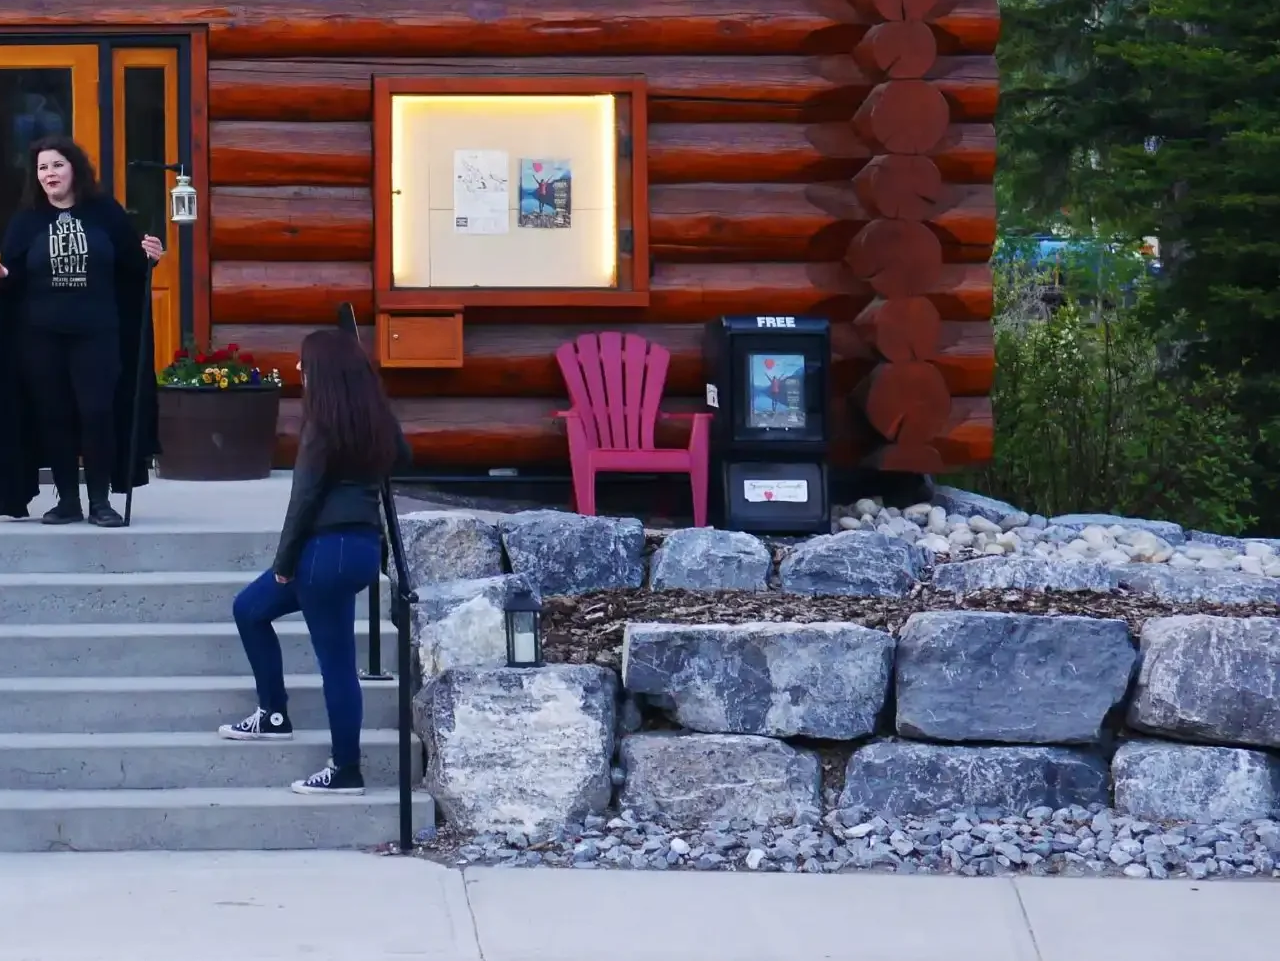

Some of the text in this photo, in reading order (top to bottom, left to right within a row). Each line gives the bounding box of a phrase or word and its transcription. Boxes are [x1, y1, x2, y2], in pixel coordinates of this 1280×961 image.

[49, 218, 84, 236] I SEEK
[49, 232, 88, 258] DEAD
[756, 316, 796, 328] FREE
